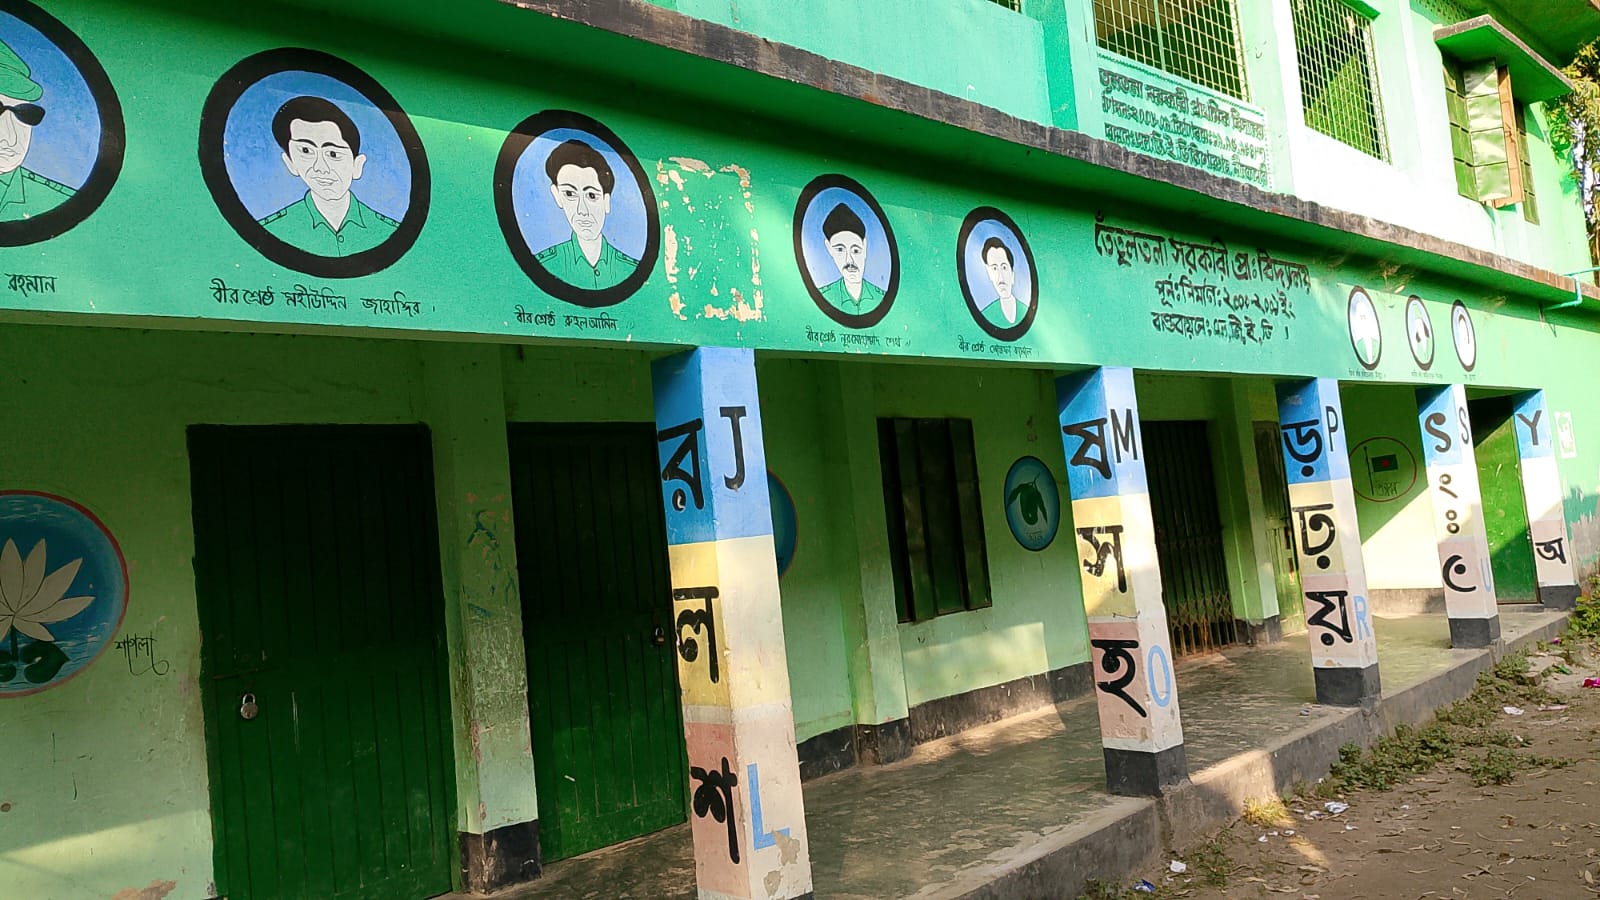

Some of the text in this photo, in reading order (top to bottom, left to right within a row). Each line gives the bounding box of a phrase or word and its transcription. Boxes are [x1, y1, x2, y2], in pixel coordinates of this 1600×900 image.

[4, 272, 59, 298] রহমান
[1168, 236, 1229, 282] সরকারী
[719, 406, 747, 490] J
[1063, 418, 1112, 479] ষ
[1110, 408, 1138, 463] M
[1281, 419, 1322, 477] ড়
[1325, 405, 1338, 452] P
[1458, 406, 1470, 445] S
[1517, 410, 1542, 446] Y
[657, 417, 704, 510] র
[1076, 525, 1127, 593] স
[1292, 503, 1336, 569] ঢ়
[1535, 537, 1566, 564] অ
[673, 586, 719, 683] ল
[1305, 591, 1353, 646] য়
[1353, 595, 1370, 640] R
[1091, 639, 1147, 718] হ
[690, 757, 738, 864] শ
[747, 763, 790, 850] L
